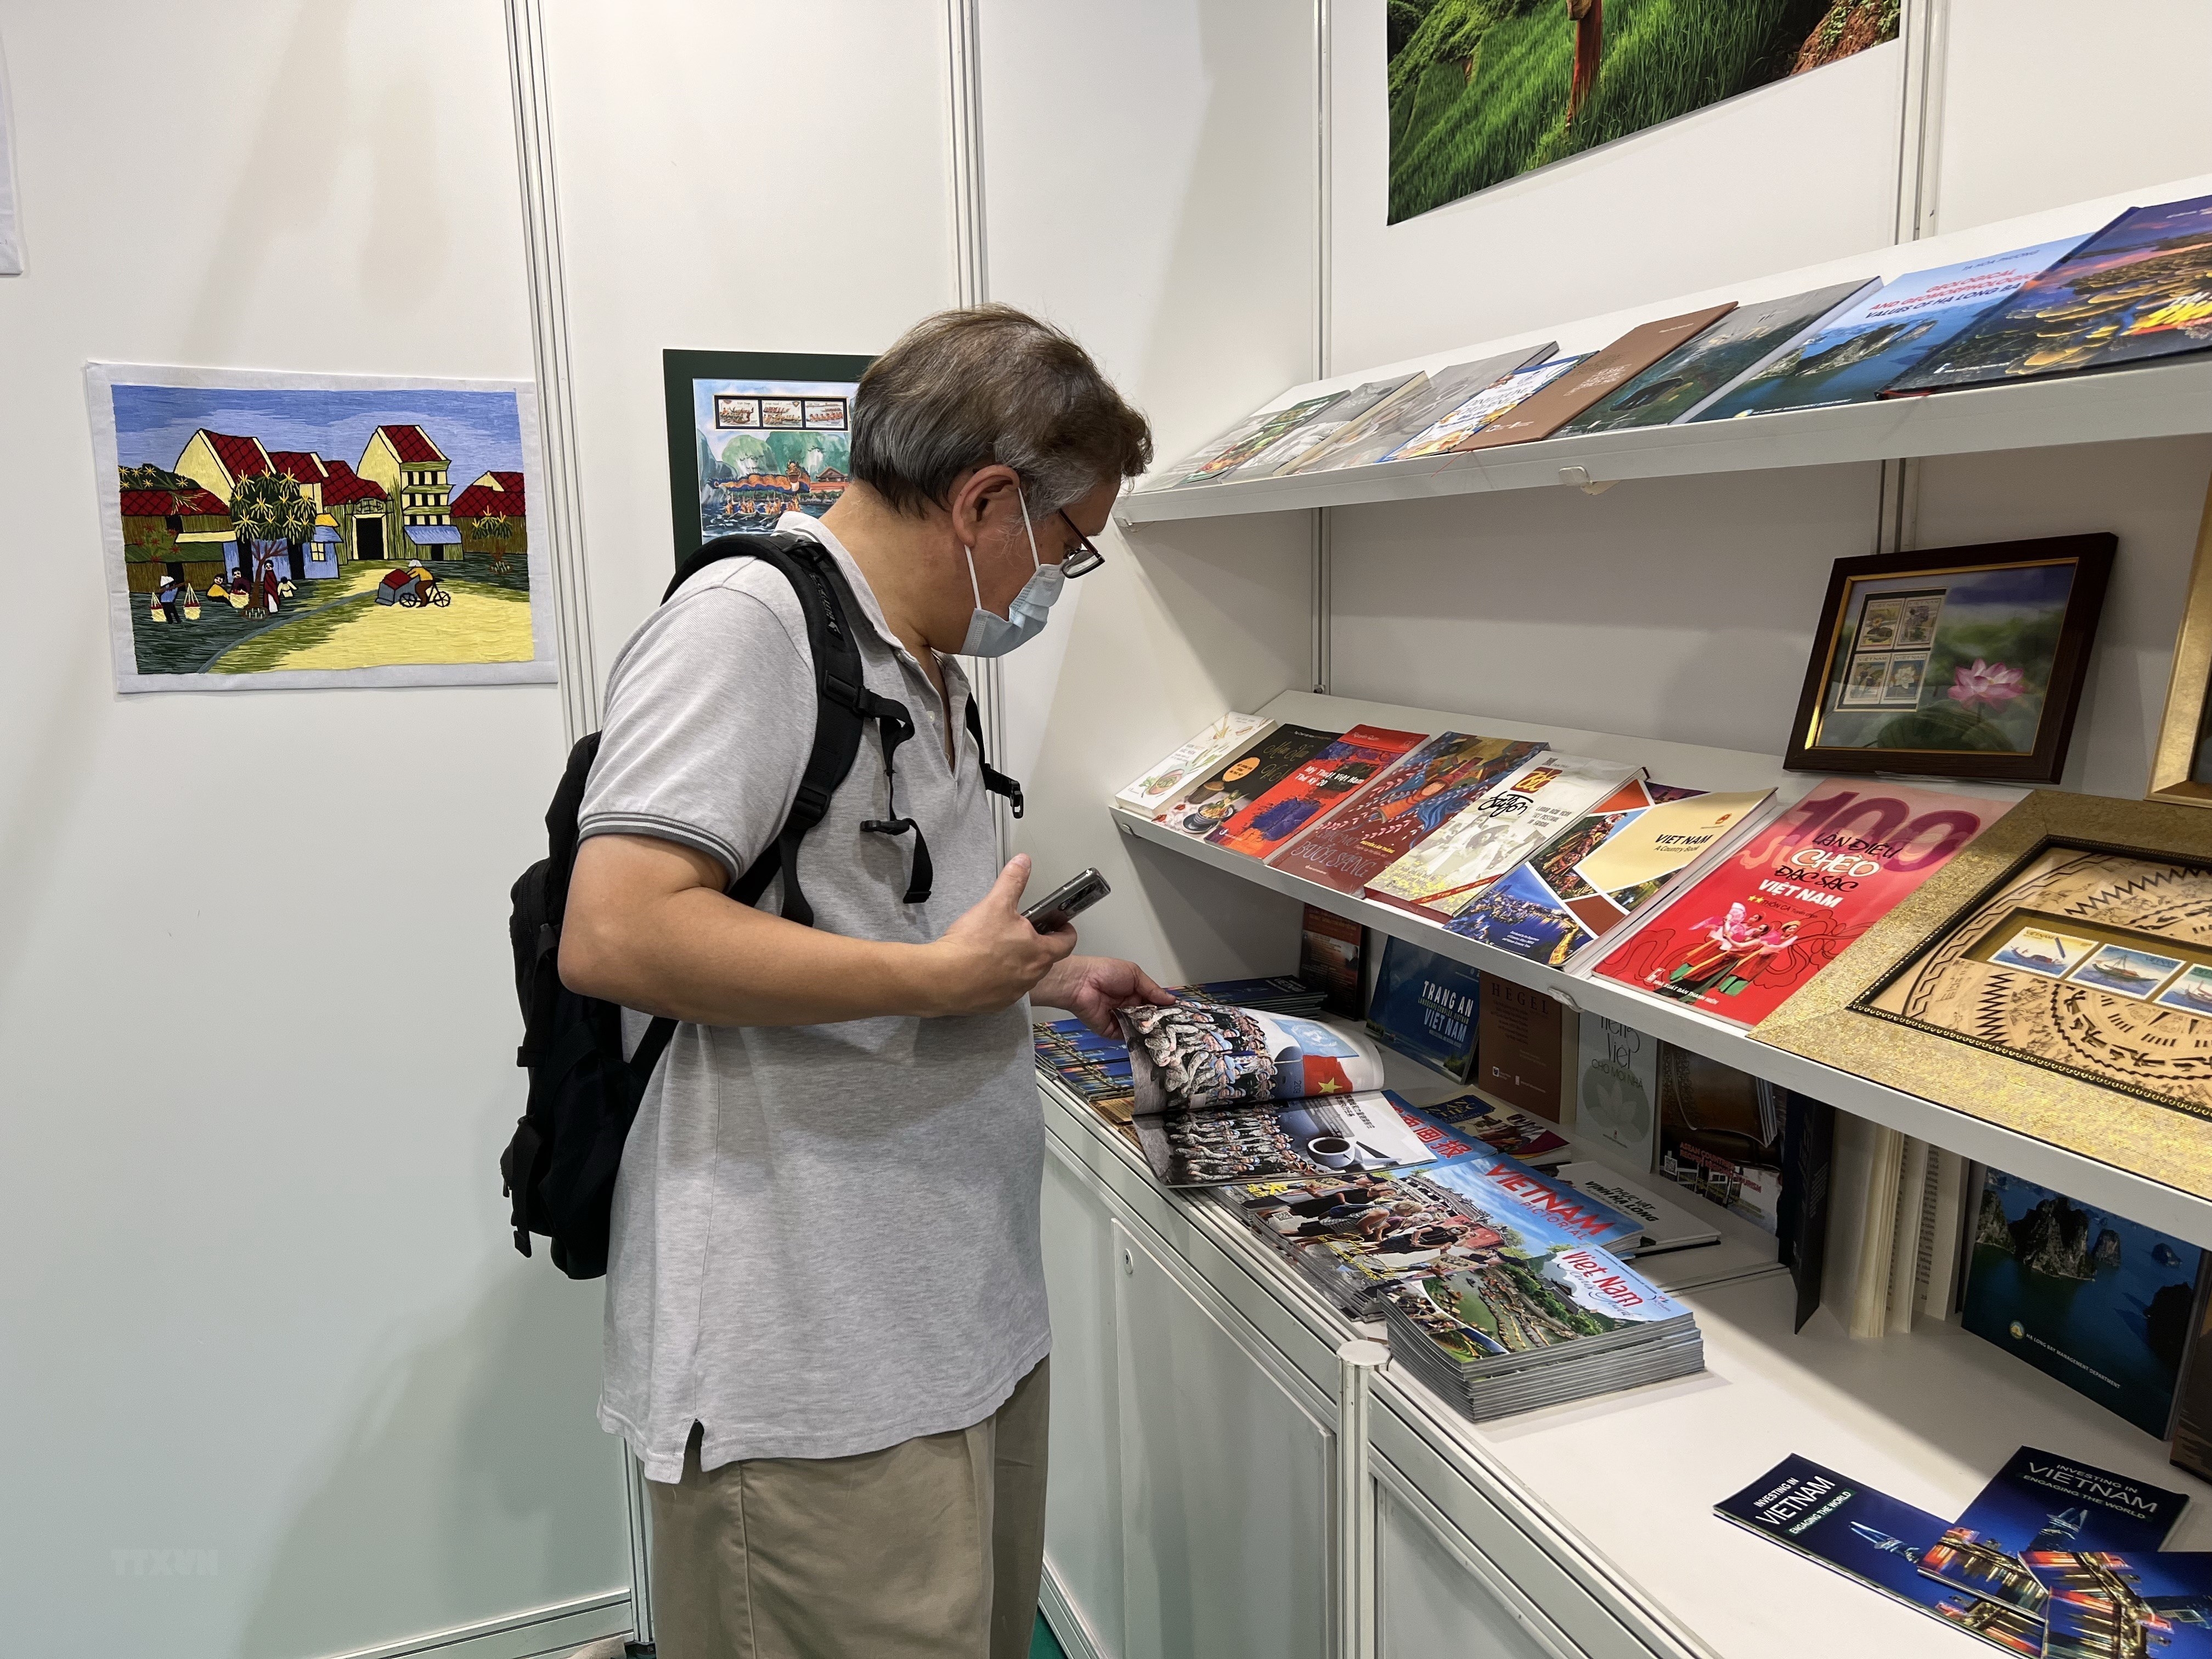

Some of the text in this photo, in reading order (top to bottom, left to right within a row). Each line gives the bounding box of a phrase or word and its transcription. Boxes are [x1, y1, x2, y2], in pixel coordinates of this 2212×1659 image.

[1926, 268, 2017, 294] GEOLOGICAL
[1865, 305, 1910, 319] VALUES
[1913, 300, 1934, 310] OF
[1955, 287, 1997, 301] LONG
[1869, 301, 1901, 311] AND
[1348, 775, 1365, 785] Nam
[1655, 834, 1714, 844] VIET NAM
[1779, 791, 1982, 872] 100
[1790, 848, 1882, 878] CHÈO
[1758, 879, 1844, 908] VIỆT NAM
[1422, 980, 1474, 1017] TRANG AN
[1491, 983, 1550, 1015] HEGEL
[1688, 991, 1707, 1001] THANH
[1424, 1007, 1446, 1031] VIET
[1444, 1018, 1468, 1042] NAM
[1592, 1059, 1610, 1074] CHO
[1485, 1163, 1616, 1236] VIETNAM
[1624, 1203, 1660, 1223] LONG
[1520, 1201, 1588, 1241] PICTORIAL
[1562, 1251, 1609, 1278] Viet
[1593, 1275, 1644, 1308] Nam
[2034, 1338, 2047, 1347] LONG
[2047, 1344, 2056, 1353] BAY
[2056, 1350, 2090, 1371] MANAGEMENT
[2089, 1368, 2121, 1389] DEPARTMENT
[1753, 1476, 1800, 1508] INVESTING IN
[2029, 1462, 2158, 1513] VIETNAM
[2057, 1464, 2138, 1494] INVESTING IN
[1755, 1475, 1836, 1526] VIETNAM
[1788, 1491, 1852, 1534] ENGAGING THE WORLD
[2023, 1475, 2146, 1519] ENGAGING THE WORLD
